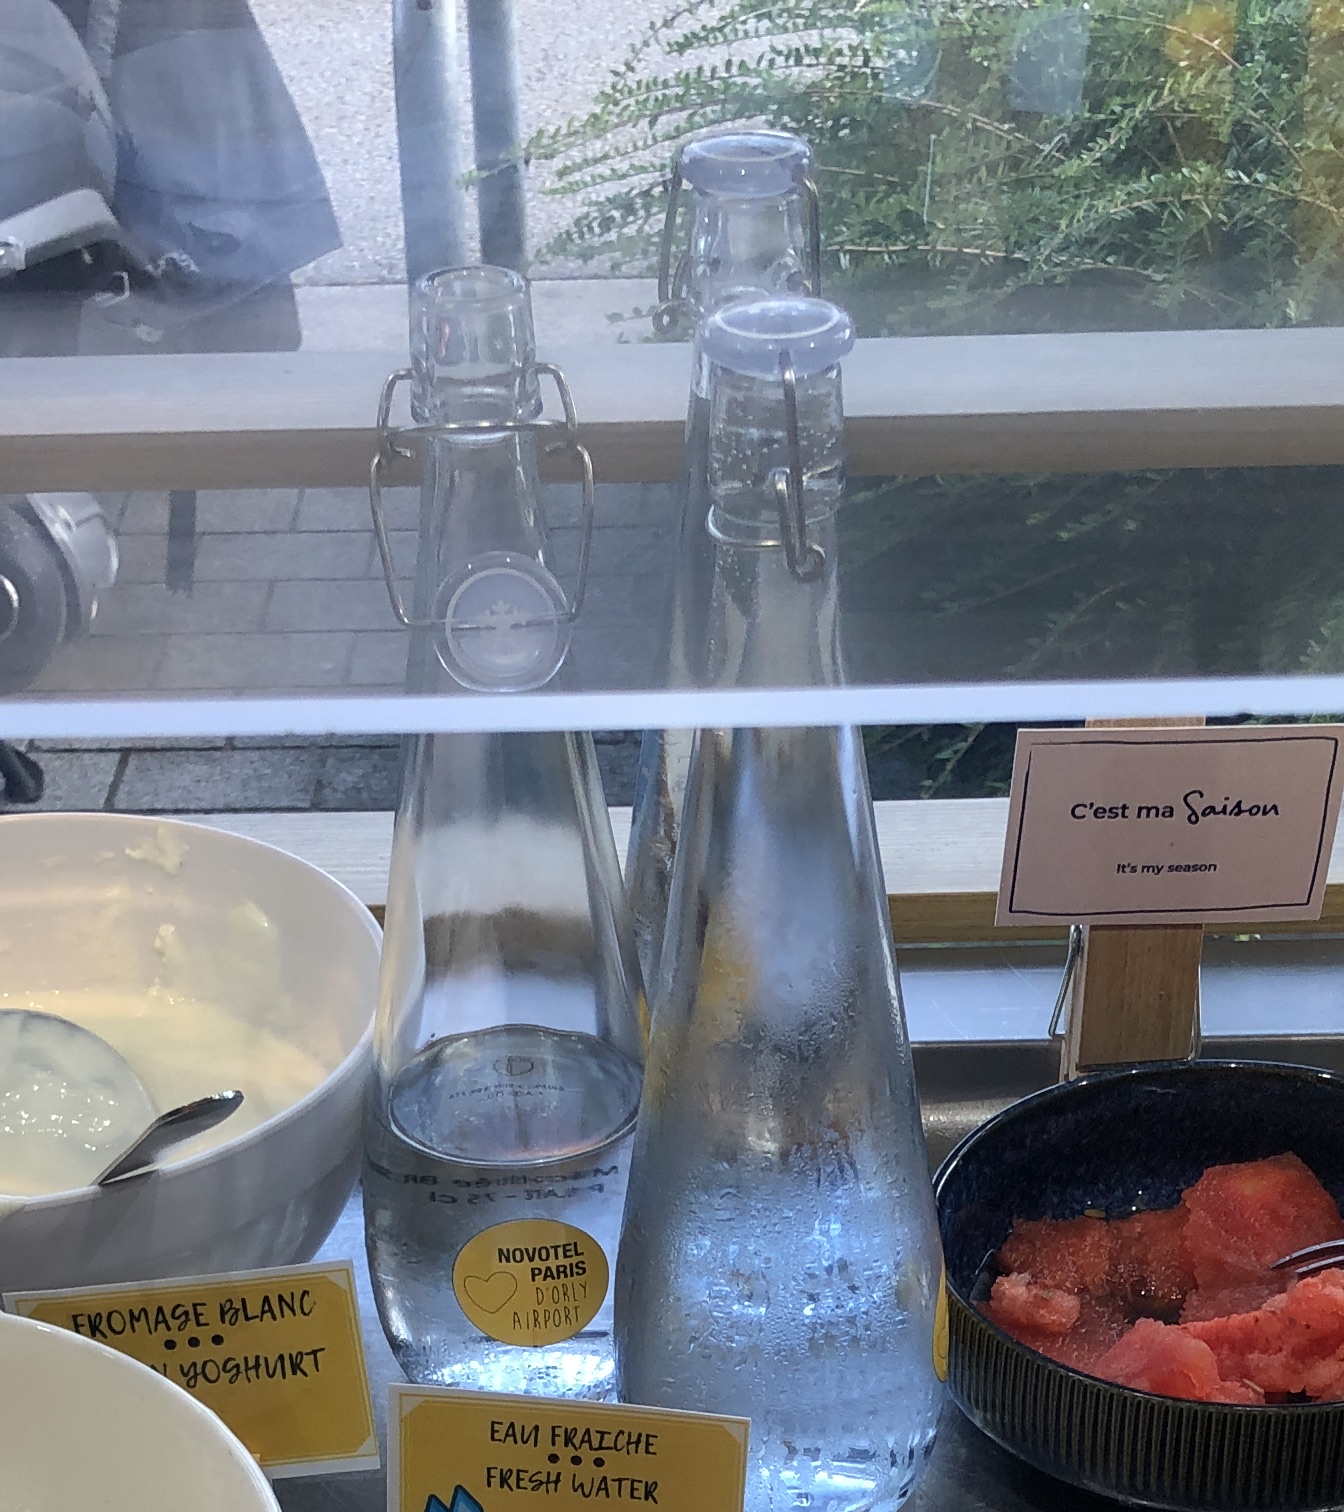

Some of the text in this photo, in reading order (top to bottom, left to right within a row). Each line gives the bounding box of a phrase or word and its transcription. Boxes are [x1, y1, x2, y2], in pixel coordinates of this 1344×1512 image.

[1070, 789, 1280, 825] C'est ma Saison
[1116, 861, 1217, 876] It's my season
[497, 1241, 584, 1264] NOVOTEL
[530, 1261, 587, 1282] PARIS
[535, 1281, 588, 1306] D'ORLY
[71, 1289, 317, 1339] FROMAGE BLANC
[512, 1306, 581, 1331] AIRPORT
[489, 1420, 659, 1455] EAU FRAICHE
[486, 1466, 659, 1505] FRESH WATER
